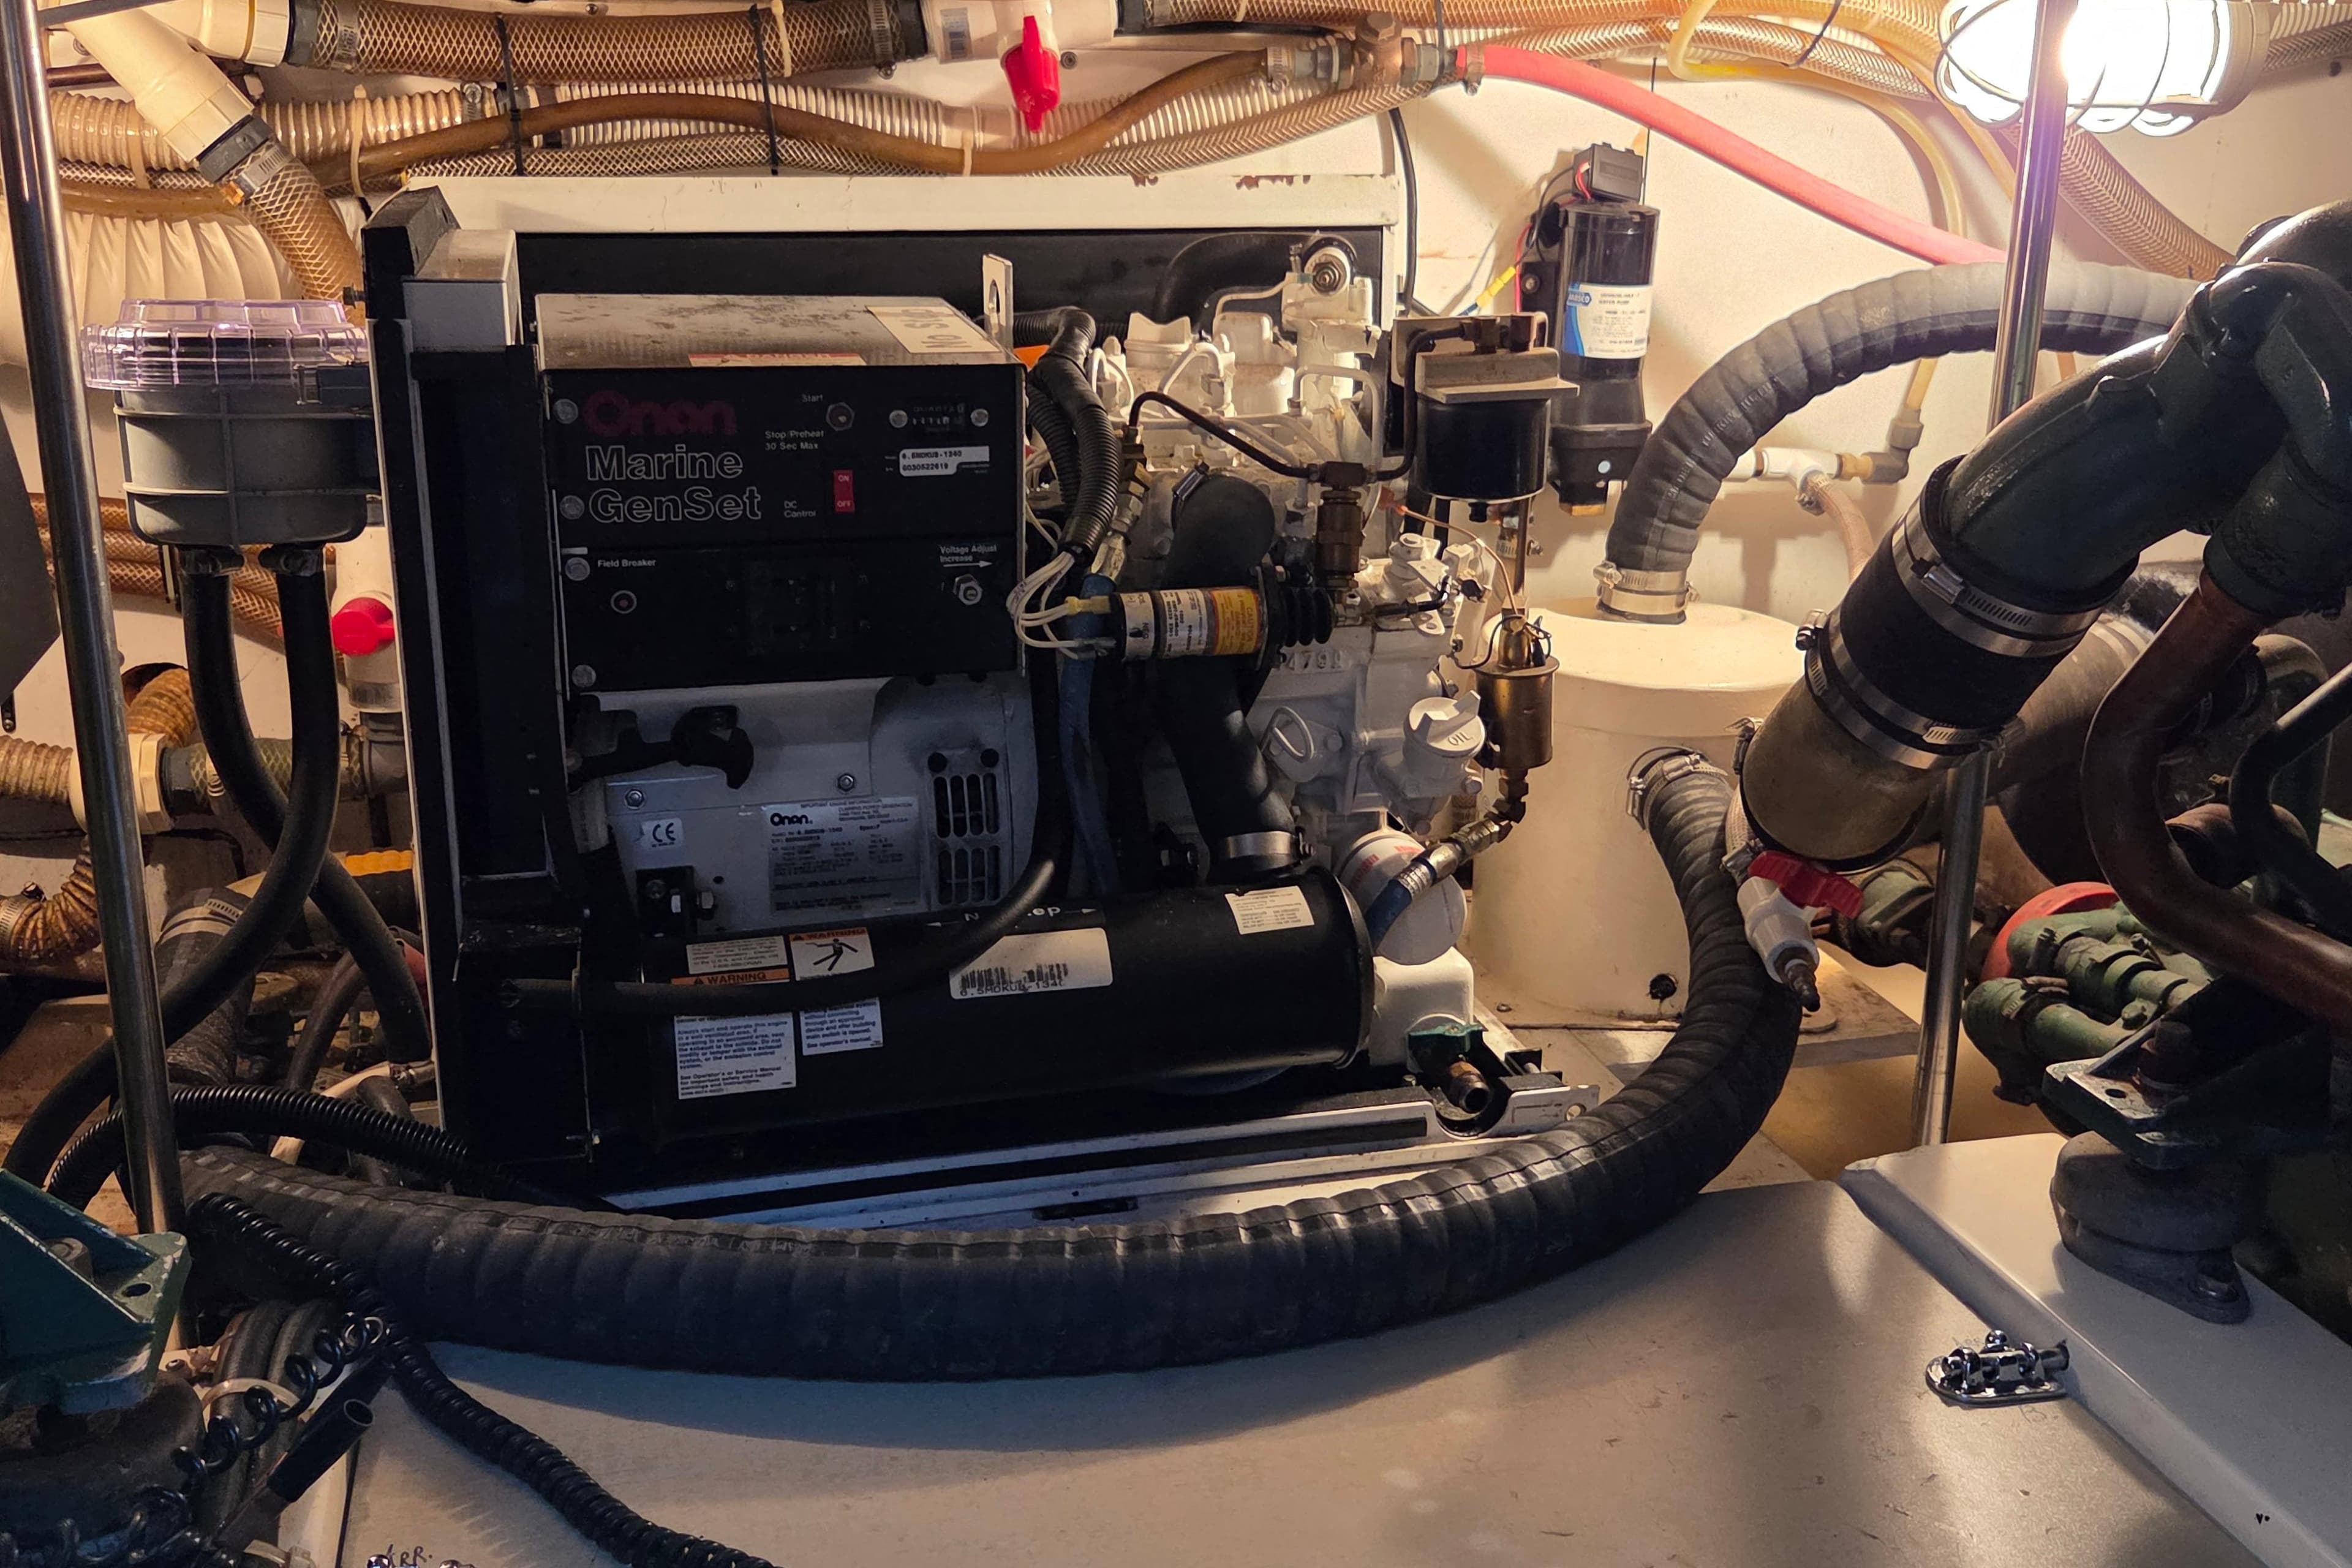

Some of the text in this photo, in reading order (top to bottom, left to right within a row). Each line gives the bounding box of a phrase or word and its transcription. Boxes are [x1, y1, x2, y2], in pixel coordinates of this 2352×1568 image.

[801, 394, 823, 402] Start
[582, 390, 737, 437] Onan
[586, 443, 744, 481] Marine
[589, 486, 761, 523] GenSet
[784, 509, 816, 518] Control
[971, 545, 997, 553] Adjust
[1449, 732, 1474, 745] OIL
[770, 812, 809, 826] Onan
[707, 972, 766, 984] WARNING
